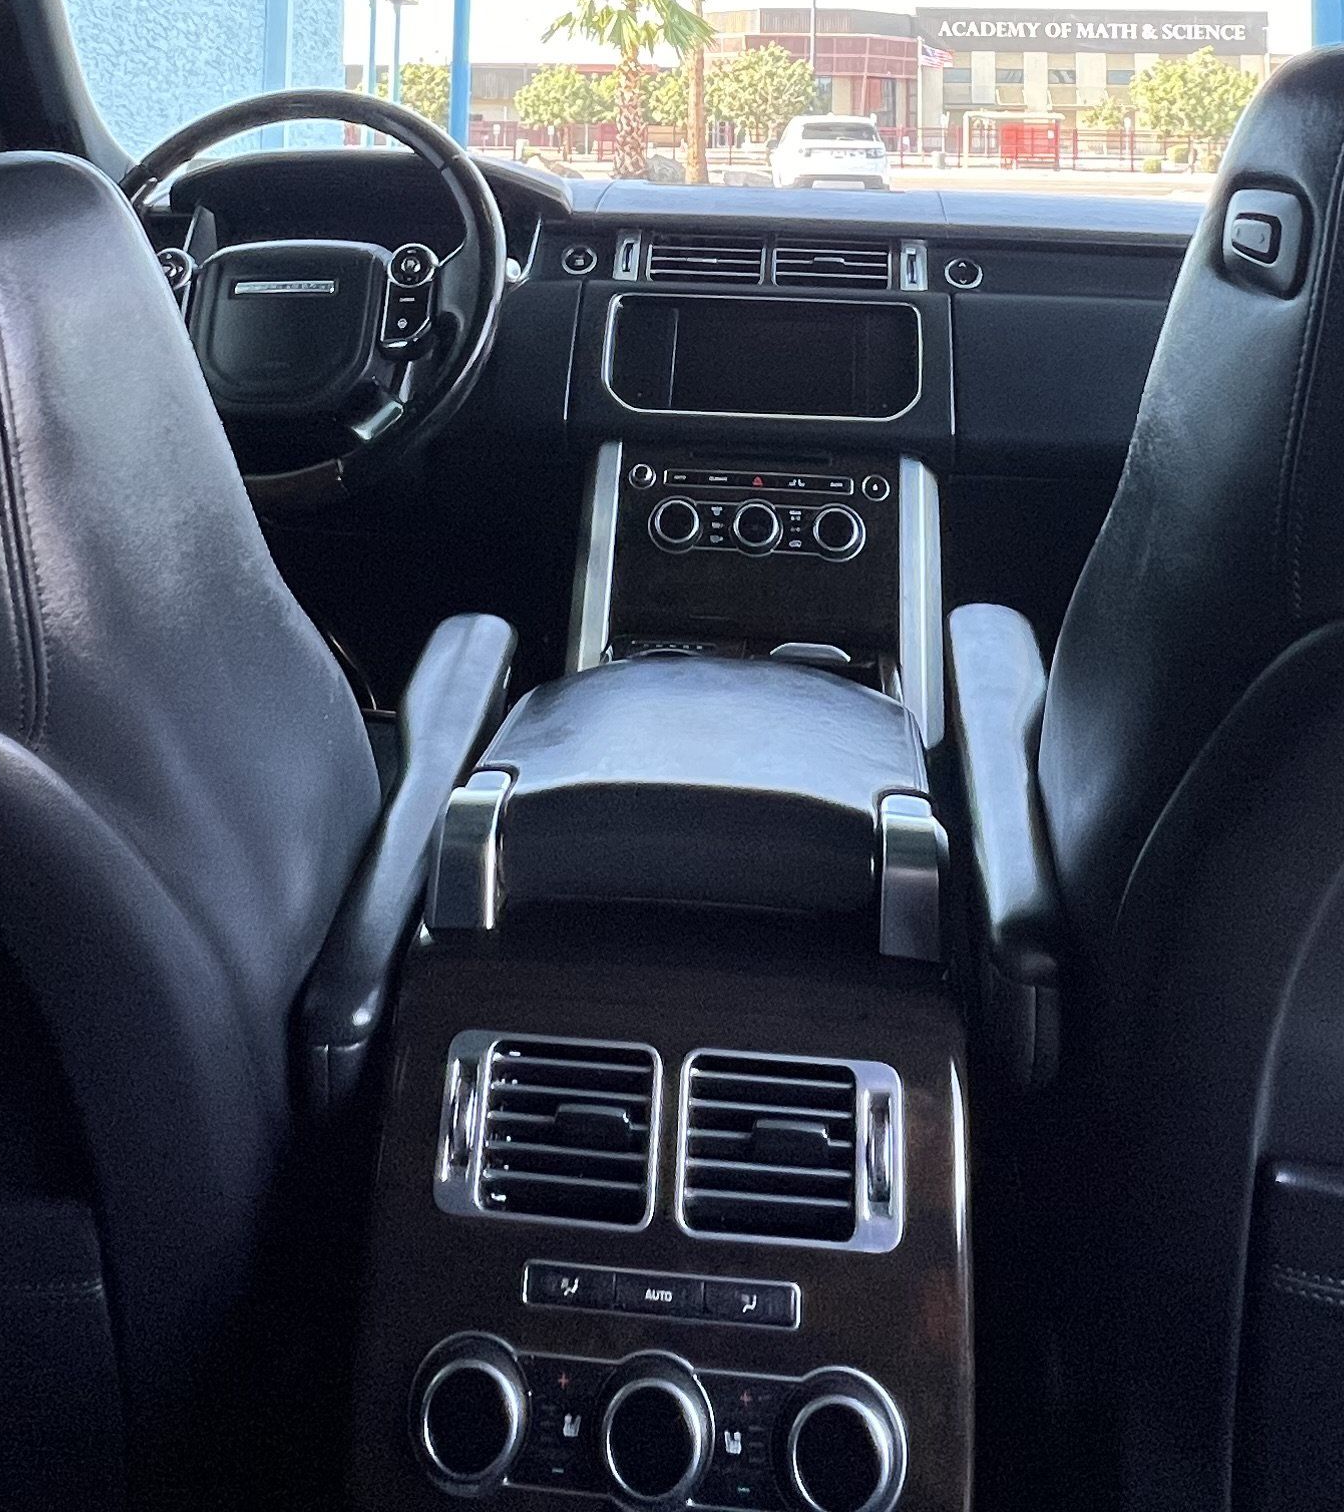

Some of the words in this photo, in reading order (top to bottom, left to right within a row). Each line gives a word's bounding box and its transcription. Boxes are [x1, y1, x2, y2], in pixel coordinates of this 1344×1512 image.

[938, 20, 1040, 38] ACADEMY
[1044, 22, 1072, 38] OF
[1075, 23, 1138, 39] MATH
[1141, 24, 1158, 39] &
[1161, 24, 1246, 40] SCIENCE
[645, 1288, 673, 1302] AUTO
